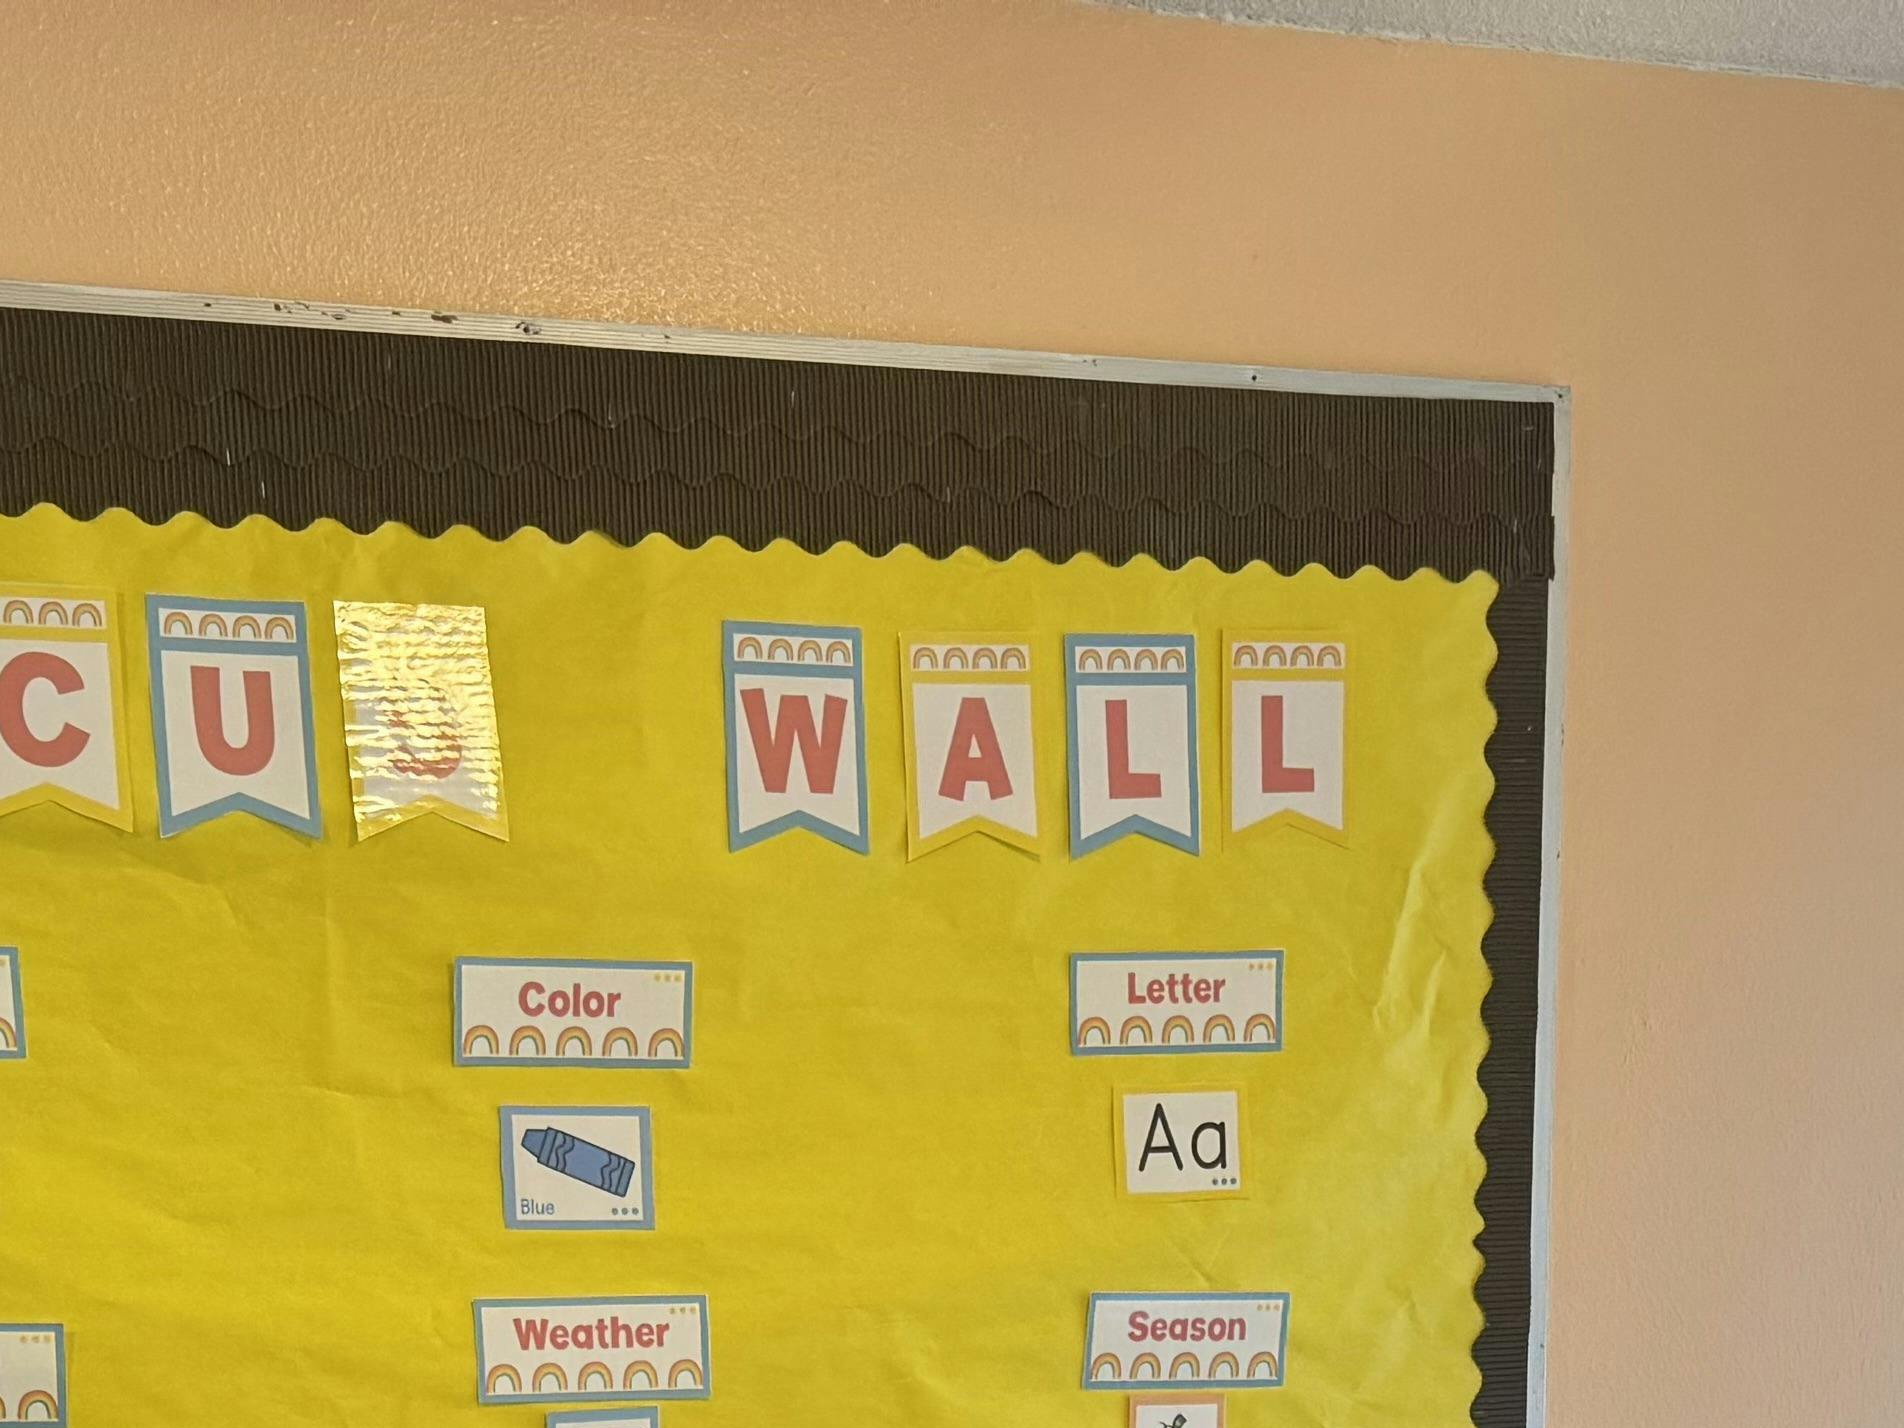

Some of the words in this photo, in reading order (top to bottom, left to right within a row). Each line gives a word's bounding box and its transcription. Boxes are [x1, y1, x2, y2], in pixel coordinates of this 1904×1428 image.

[739, 688, 1315, 801] WALL
[518, 981, 622, 1018] Color
[1127, 972, 1226, 1005] Letter
[1138, 1103, 1227, 1172] Aa
[520, 1198, 555, 1216] Blue
[513, 1316, 670, 1351] Weather
[1128, 1311, 1246, 1342] Season
